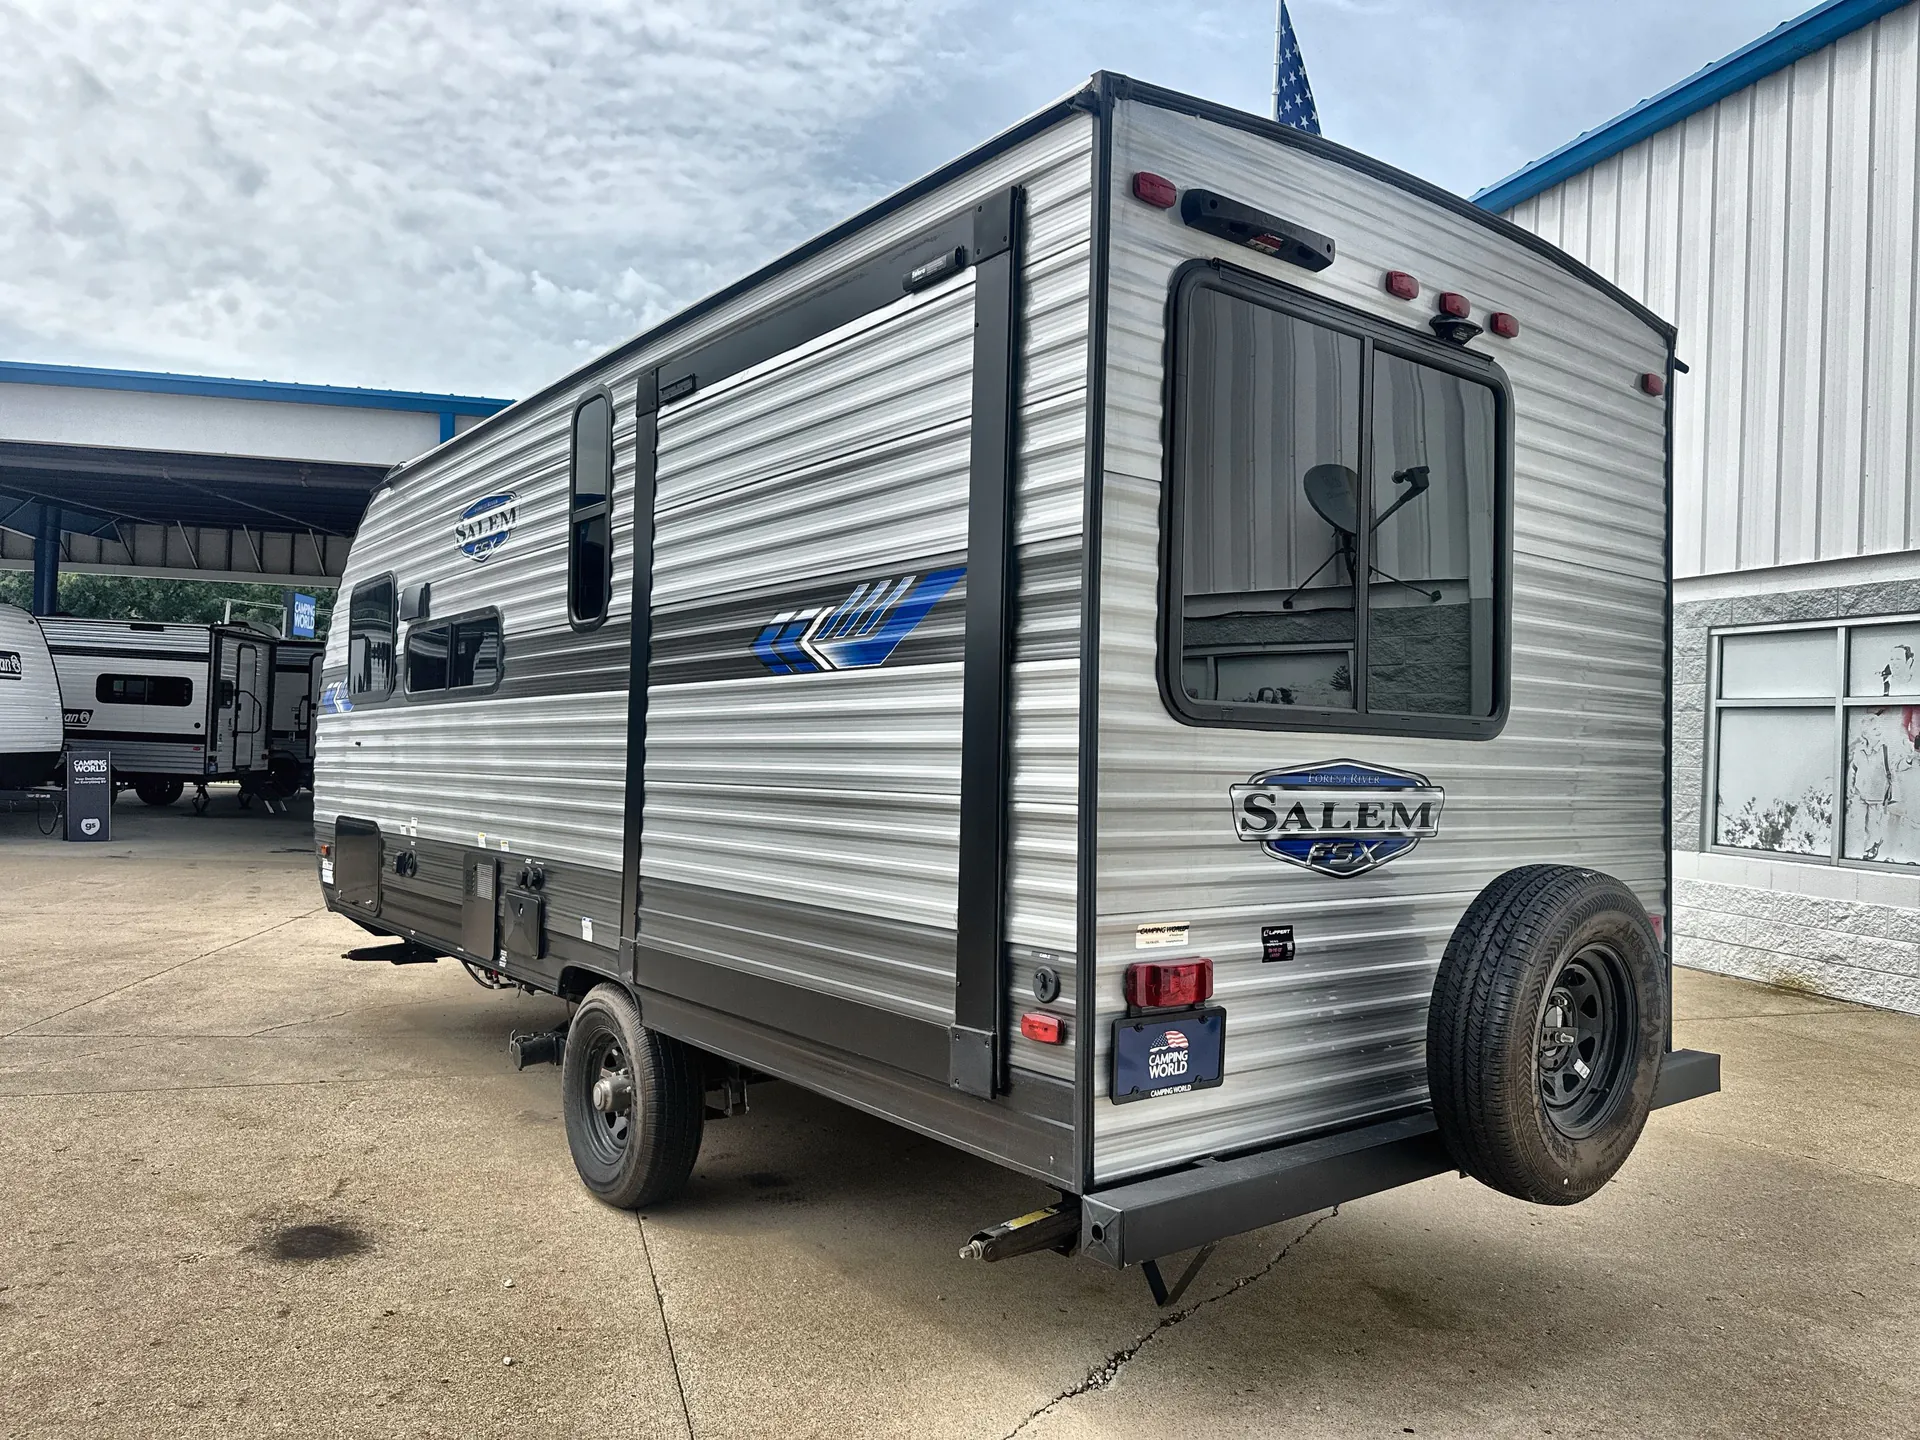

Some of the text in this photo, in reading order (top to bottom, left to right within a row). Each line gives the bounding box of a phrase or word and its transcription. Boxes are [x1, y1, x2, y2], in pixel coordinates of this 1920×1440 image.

[456, 507, 516, 543] SALEM
[295, 601, 315, 616] CAMPING
[294, 613, 315, 630] WORLD
[1307, 772, 1380, 784] FOREST RIVER
[1241, 793, 1435, 832] SALEM
[85, 822, 96, 831] gs
[1306, 841, 1385, 867] FSX
[1140, 926, 1166, 934] CAMPING
[1149, 1050, 1188, 1066] CAMPING
[1149, 1061, 1188, 1080] WORLD
[1150, 1084, 1191, 1097] CAMPING WORLD
